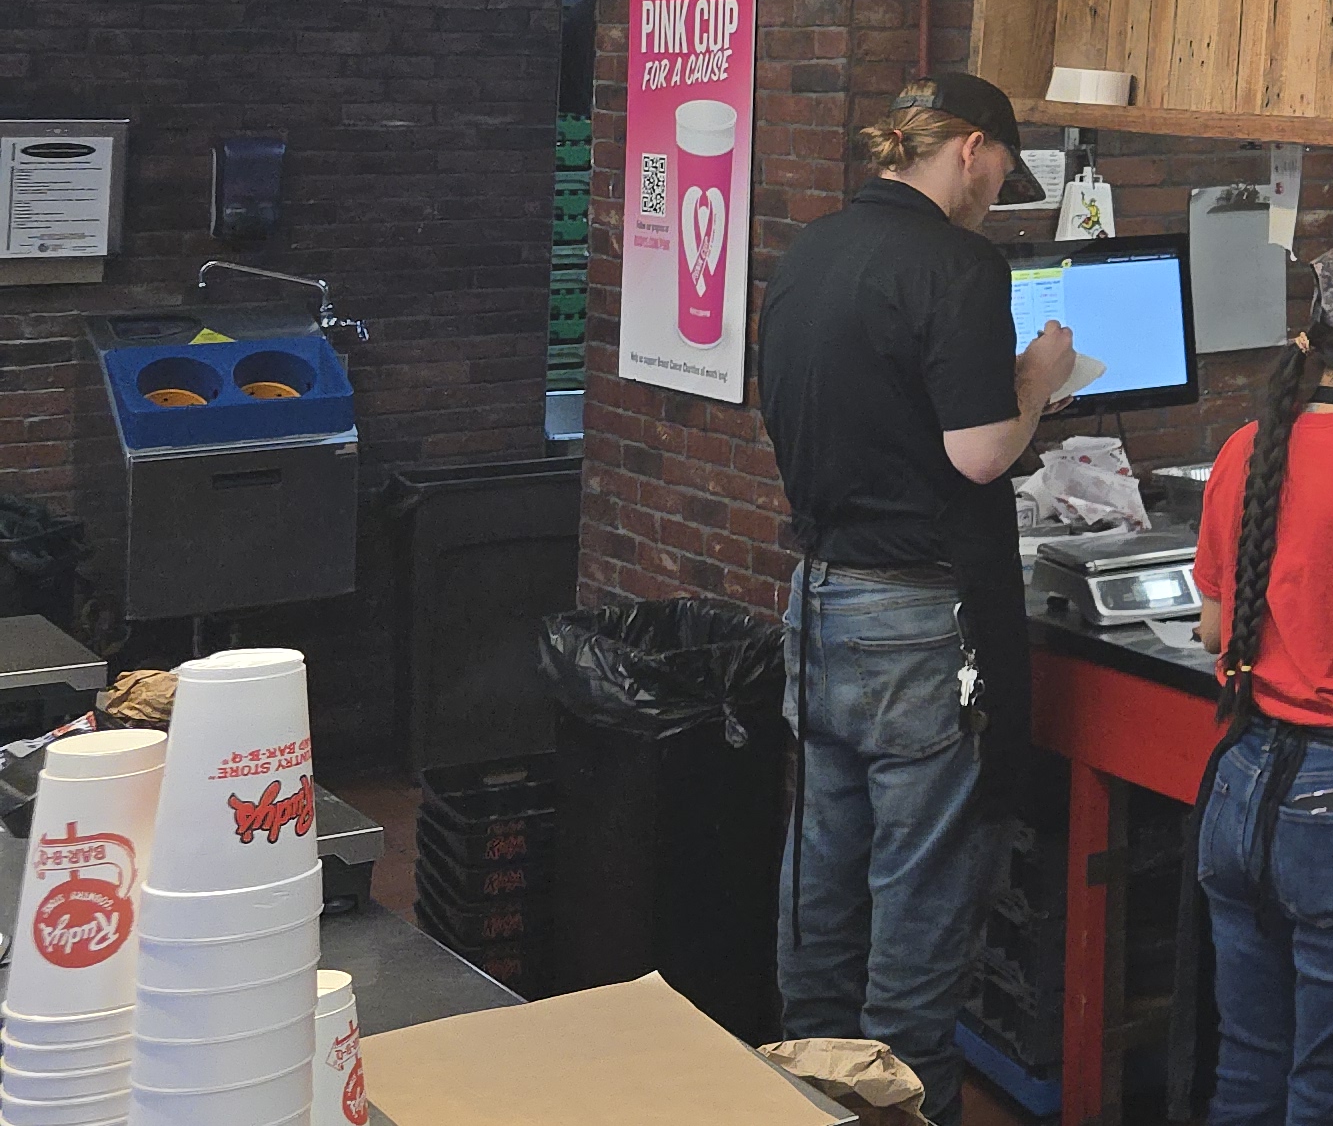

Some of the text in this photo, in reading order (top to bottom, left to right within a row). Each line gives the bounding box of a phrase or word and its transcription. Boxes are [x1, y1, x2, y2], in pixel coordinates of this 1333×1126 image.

[641, 0, 689, 53] PINK
[642, 49, 732, 91] FOR A CAUSE
